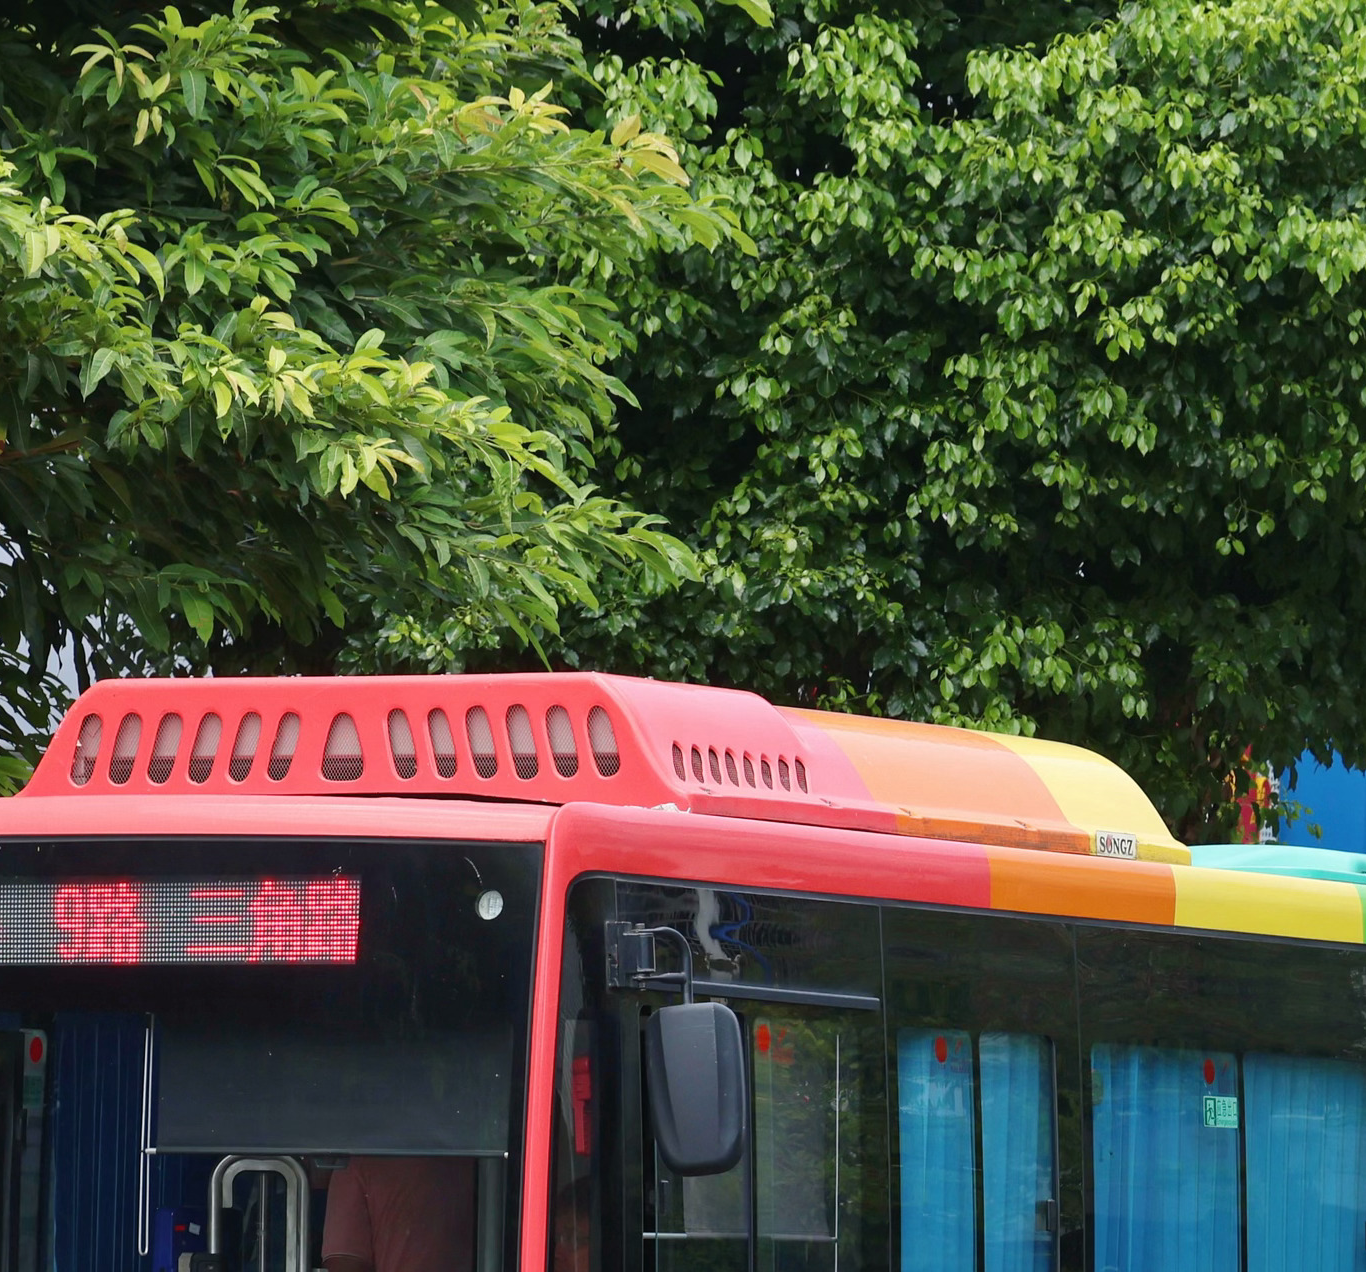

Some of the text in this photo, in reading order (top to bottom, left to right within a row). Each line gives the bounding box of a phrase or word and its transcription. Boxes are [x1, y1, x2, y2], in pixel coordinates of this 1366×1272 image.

[1100, 834, 1133, 856] SONGZ
[55, 882, 146, 963] 9路
[186, 879, 359, 963] 三角路
